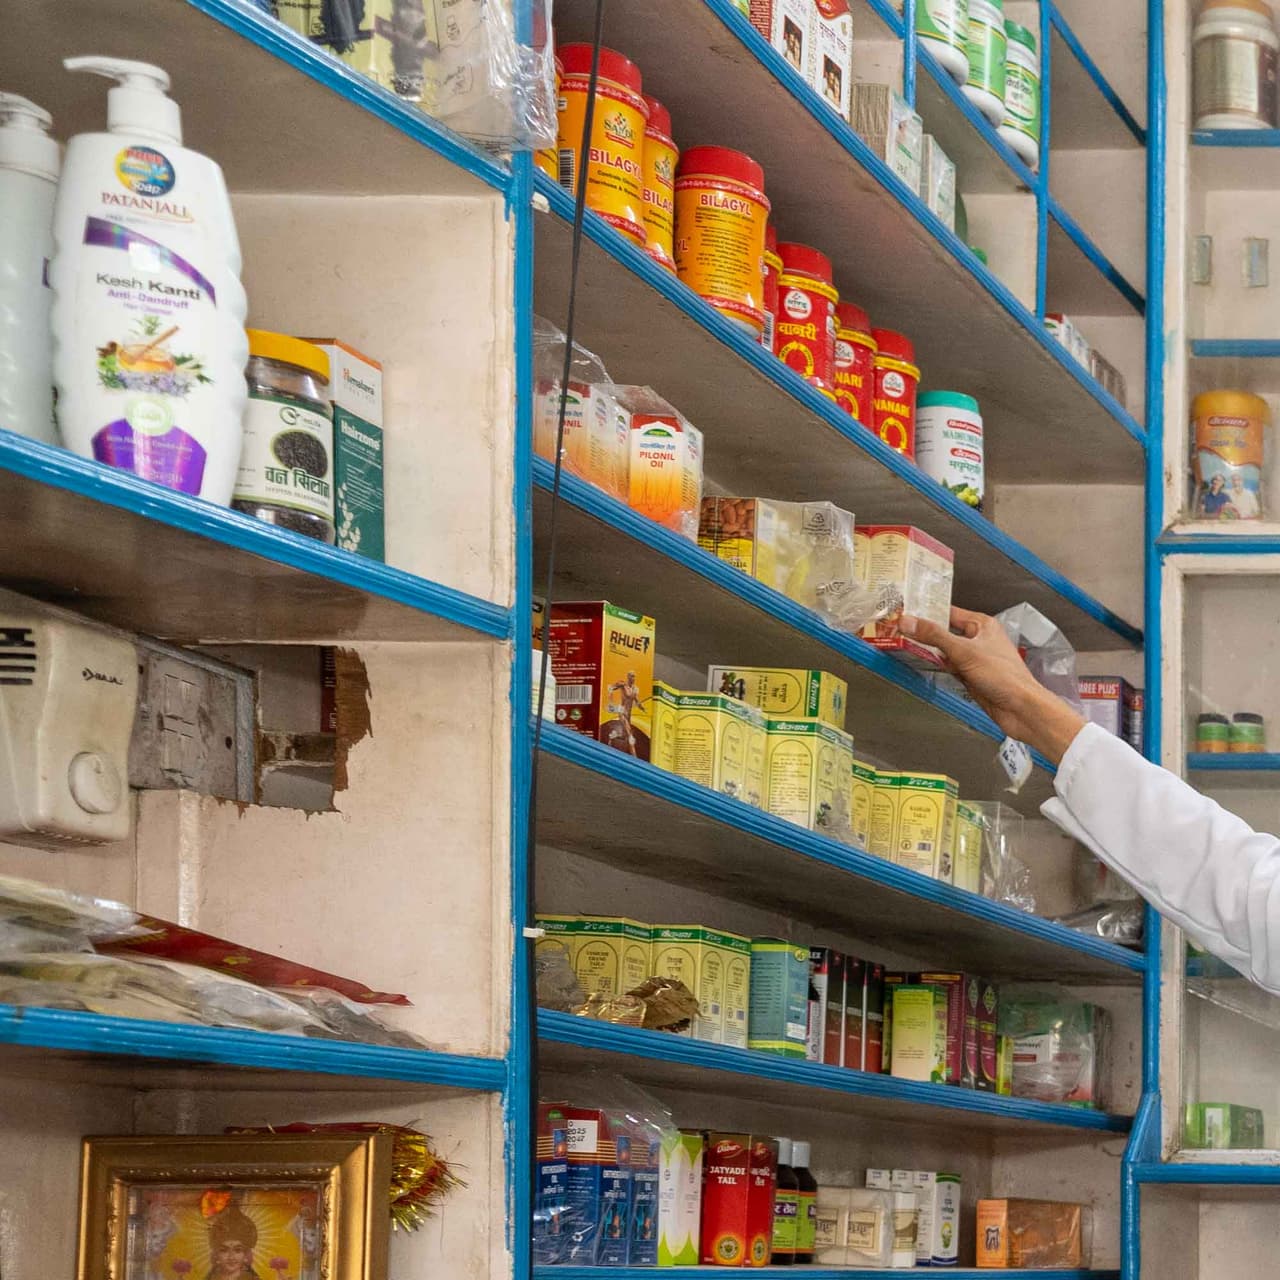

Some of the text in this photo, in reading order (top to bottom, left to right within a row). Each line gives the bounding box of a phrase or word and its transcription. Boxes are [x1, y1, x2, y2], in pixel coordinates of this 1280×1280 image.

[101, 191, 189, 218] PATANJALI
[700, 194, 752, 216] BILAGYL
[96, 272, 201, 300] Kesh Kanti
[834, 371, 863, 387] NARI
[873, 398, 911, 418] VANARI
[339, 418, 381, 451] Hairzone
[639, 451, 676, 461] PILONIL
[709, 1165, 746, 1176] JATYADI
[717, 1176, 737, 1186] TAIL
